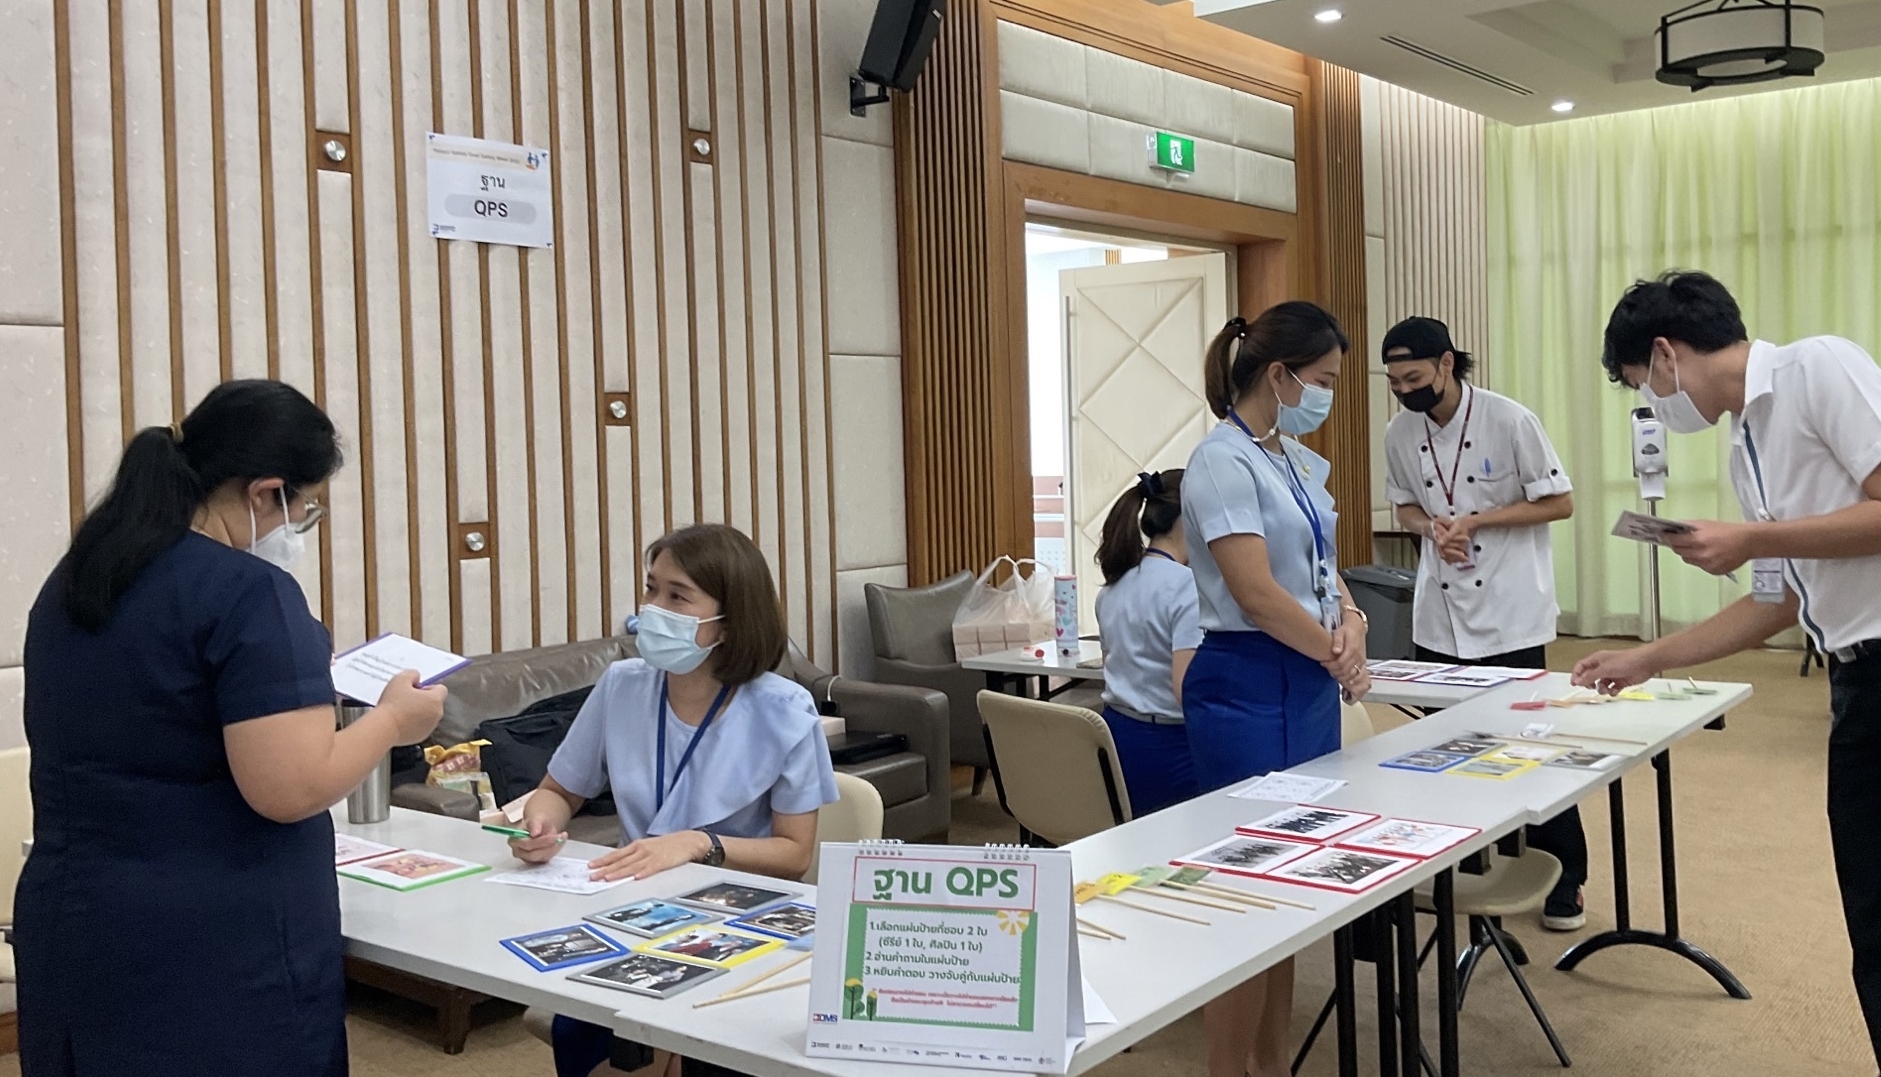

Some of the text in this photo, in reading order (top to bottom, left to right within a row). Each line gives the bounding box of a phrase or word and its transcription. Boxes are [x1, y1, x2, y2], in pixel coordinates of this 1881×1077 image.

[480, 175, 506, 192] ฐาน
[474, 200, 508, 218] QPS
[872, 867, 1019, 900] ฐาน QPS
[967, 926, 974, 936] 2
[976, 927, 988, 937] ใบ
[905, 938, 910, 948] 1
